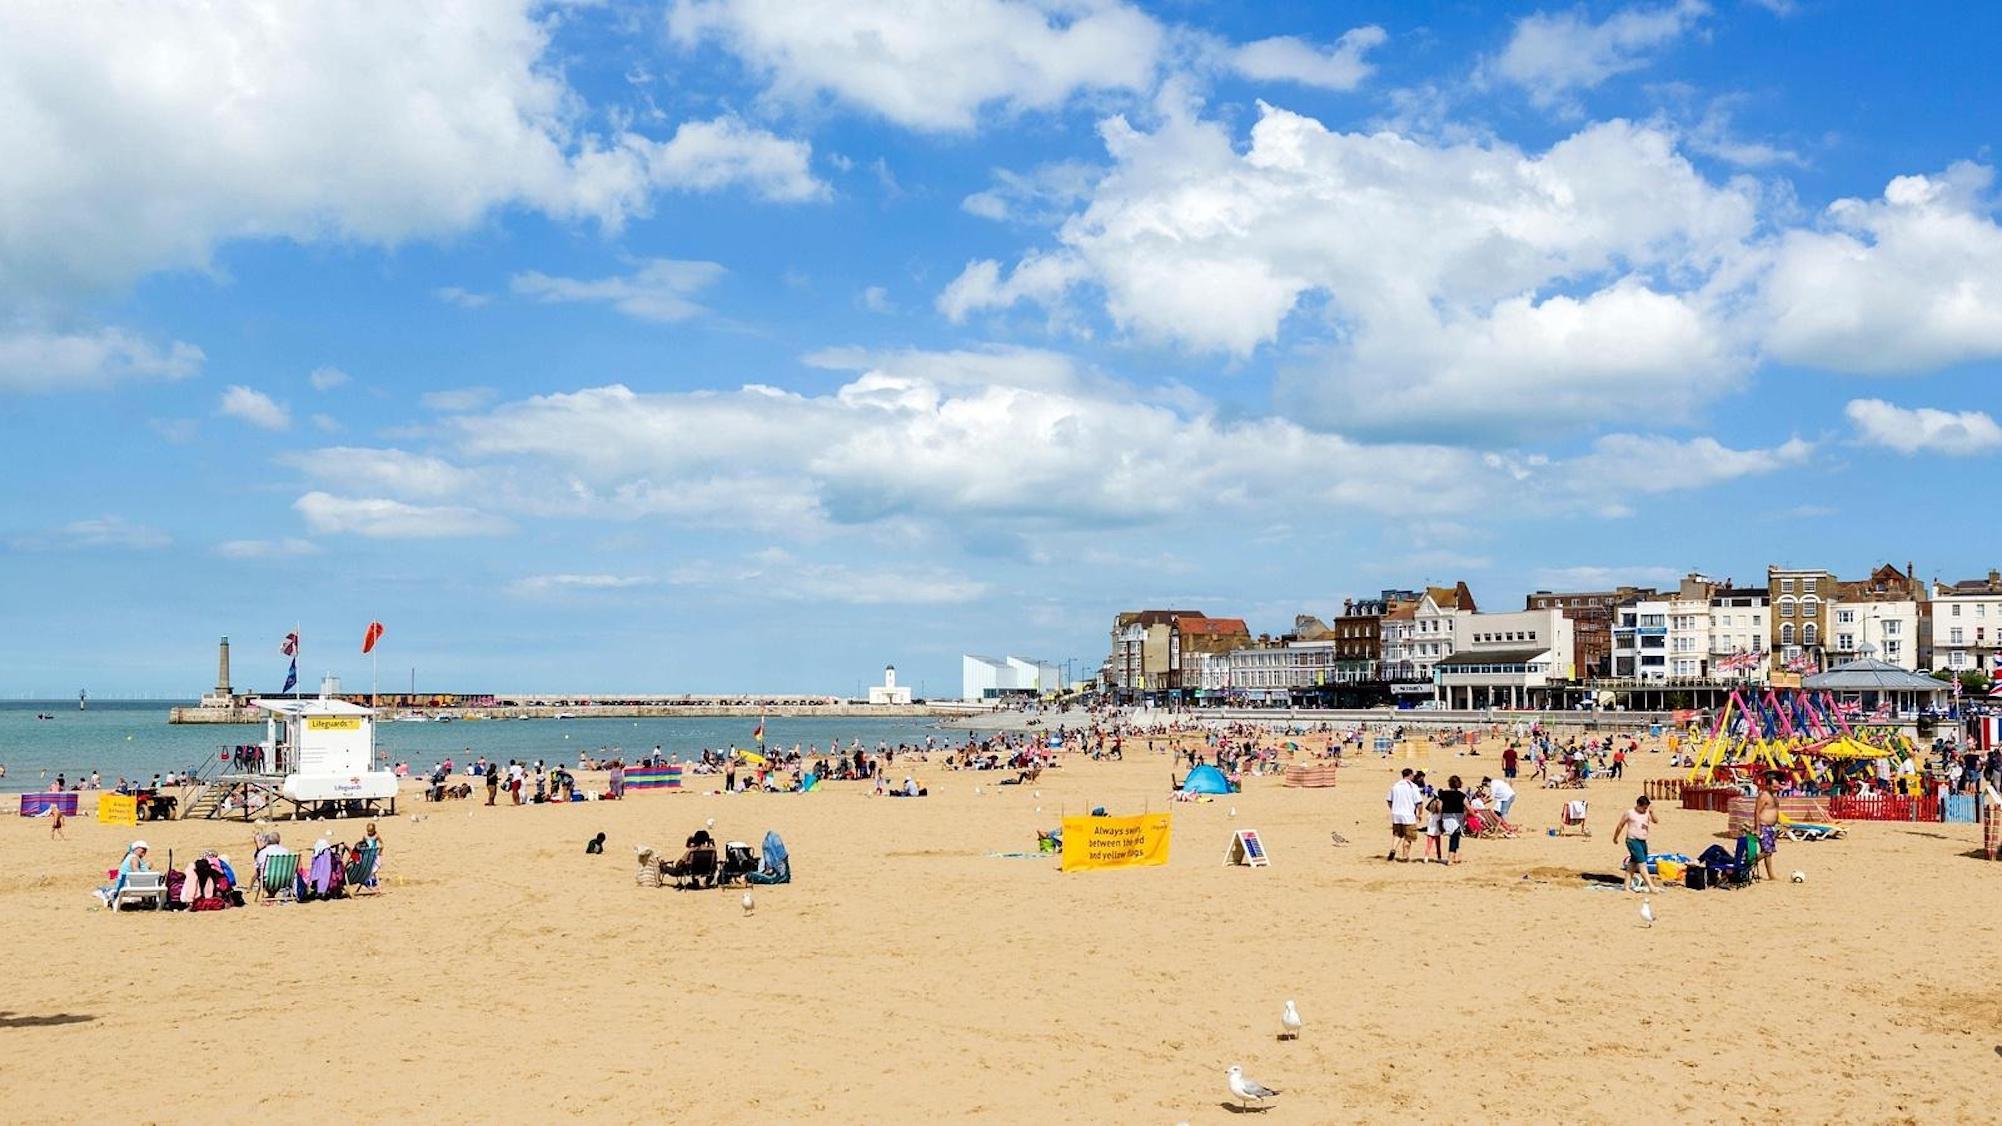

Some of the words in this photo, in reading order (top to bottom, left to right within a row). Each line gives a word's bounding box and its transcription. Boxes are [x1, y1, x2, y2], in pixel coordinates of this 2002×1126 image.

[312, 720, 347, 729] Lifeguards
[1094, 826, 1123, 837] Always
[1089, 839, 1120, 848] between
[1089, 851, 1101, 860] and
[1102, 851, 1126, 861] yellow
